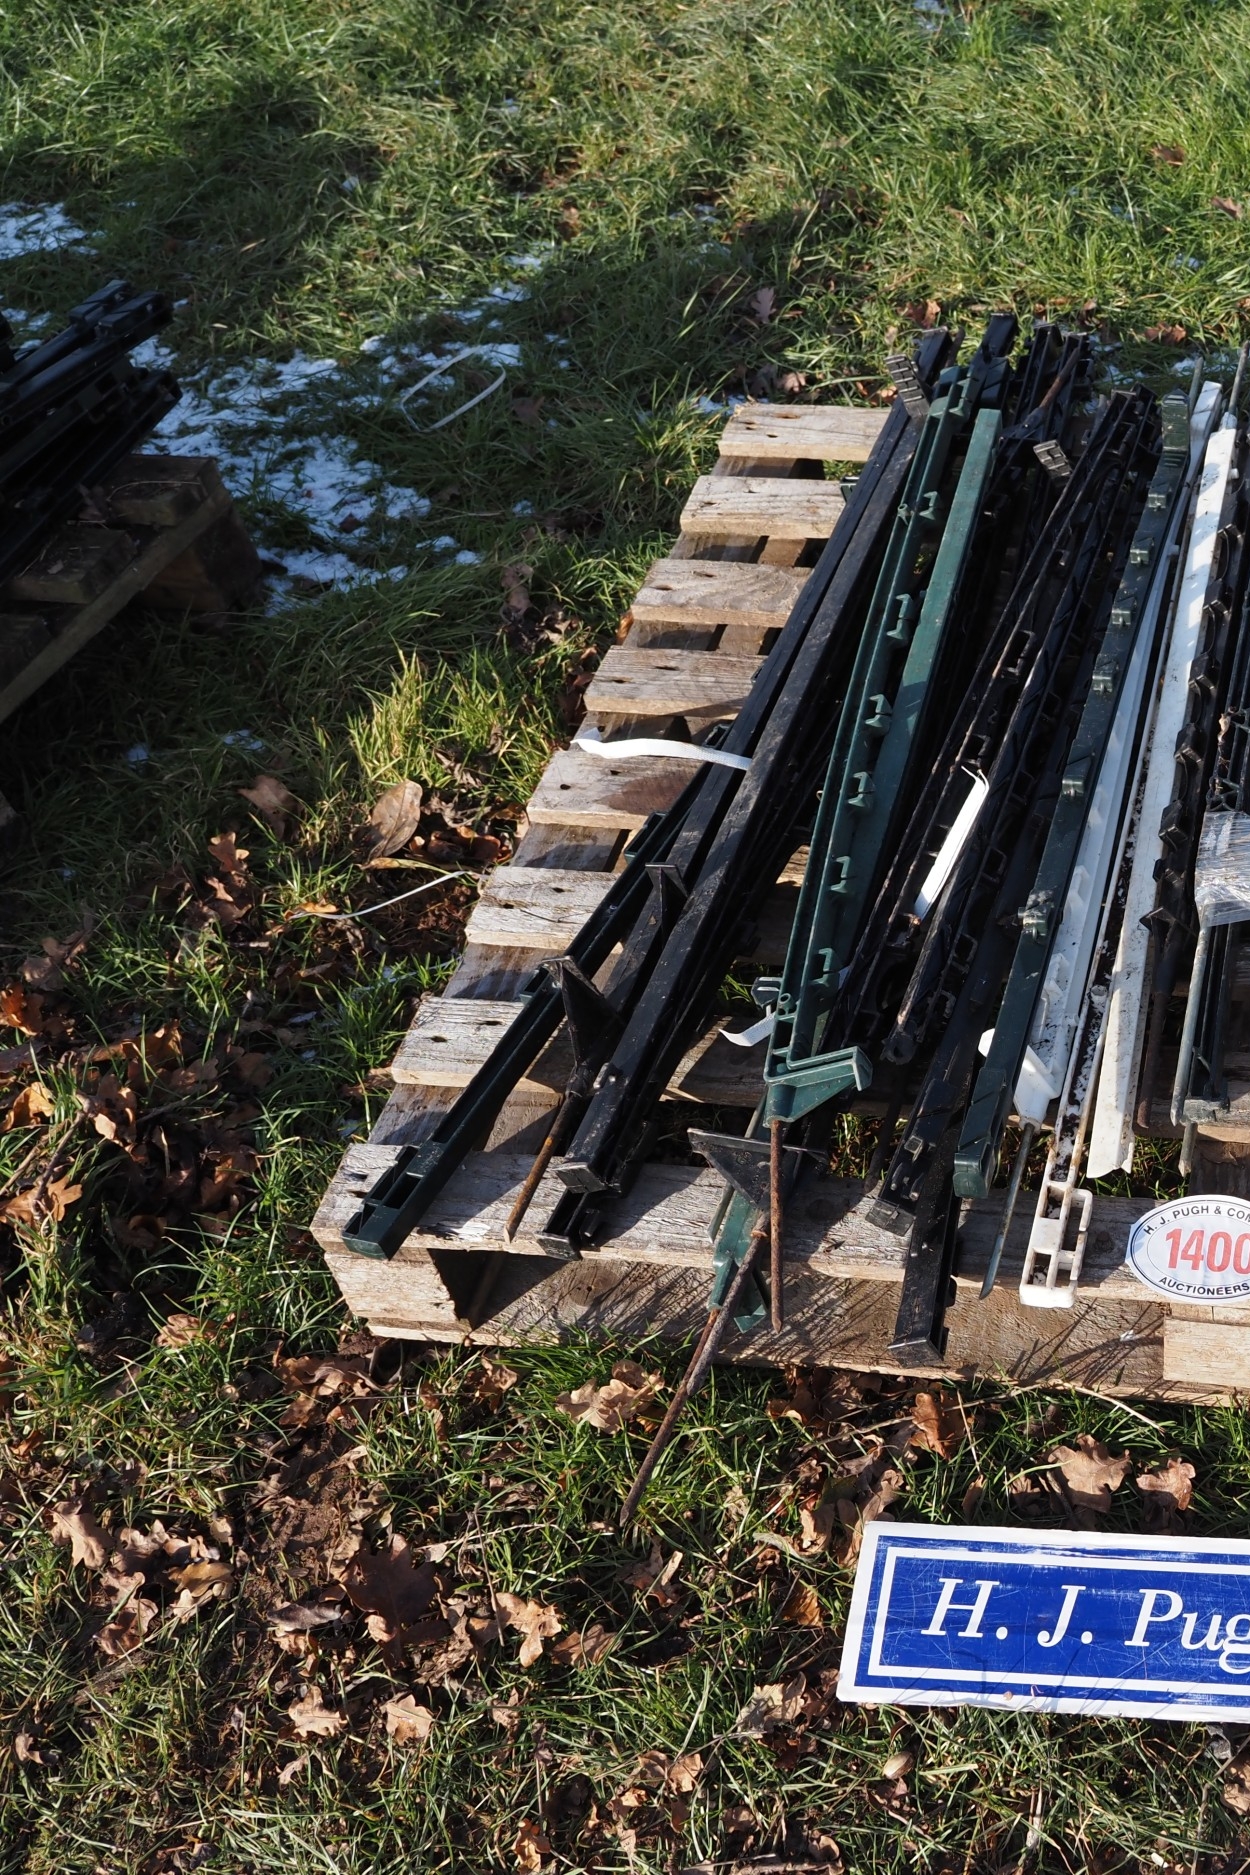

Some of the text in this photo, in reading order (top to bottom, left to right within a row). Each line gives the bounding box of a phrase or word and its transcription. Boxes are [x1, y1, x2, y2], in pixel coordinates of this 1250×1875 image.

[1143, 1224, 1158, 1236] H.
[1159, 1216, 1170, 1225] J.
[1172, 1205, 1209, 1219] PUGH
[1213, 1206, 1222, 1215] &
[1158, 1276, 1250, 1296] AUCTIONEERS
[920, 1577, 1009, 1640] H.
[1037, 1584, 1094, 1649] J.
